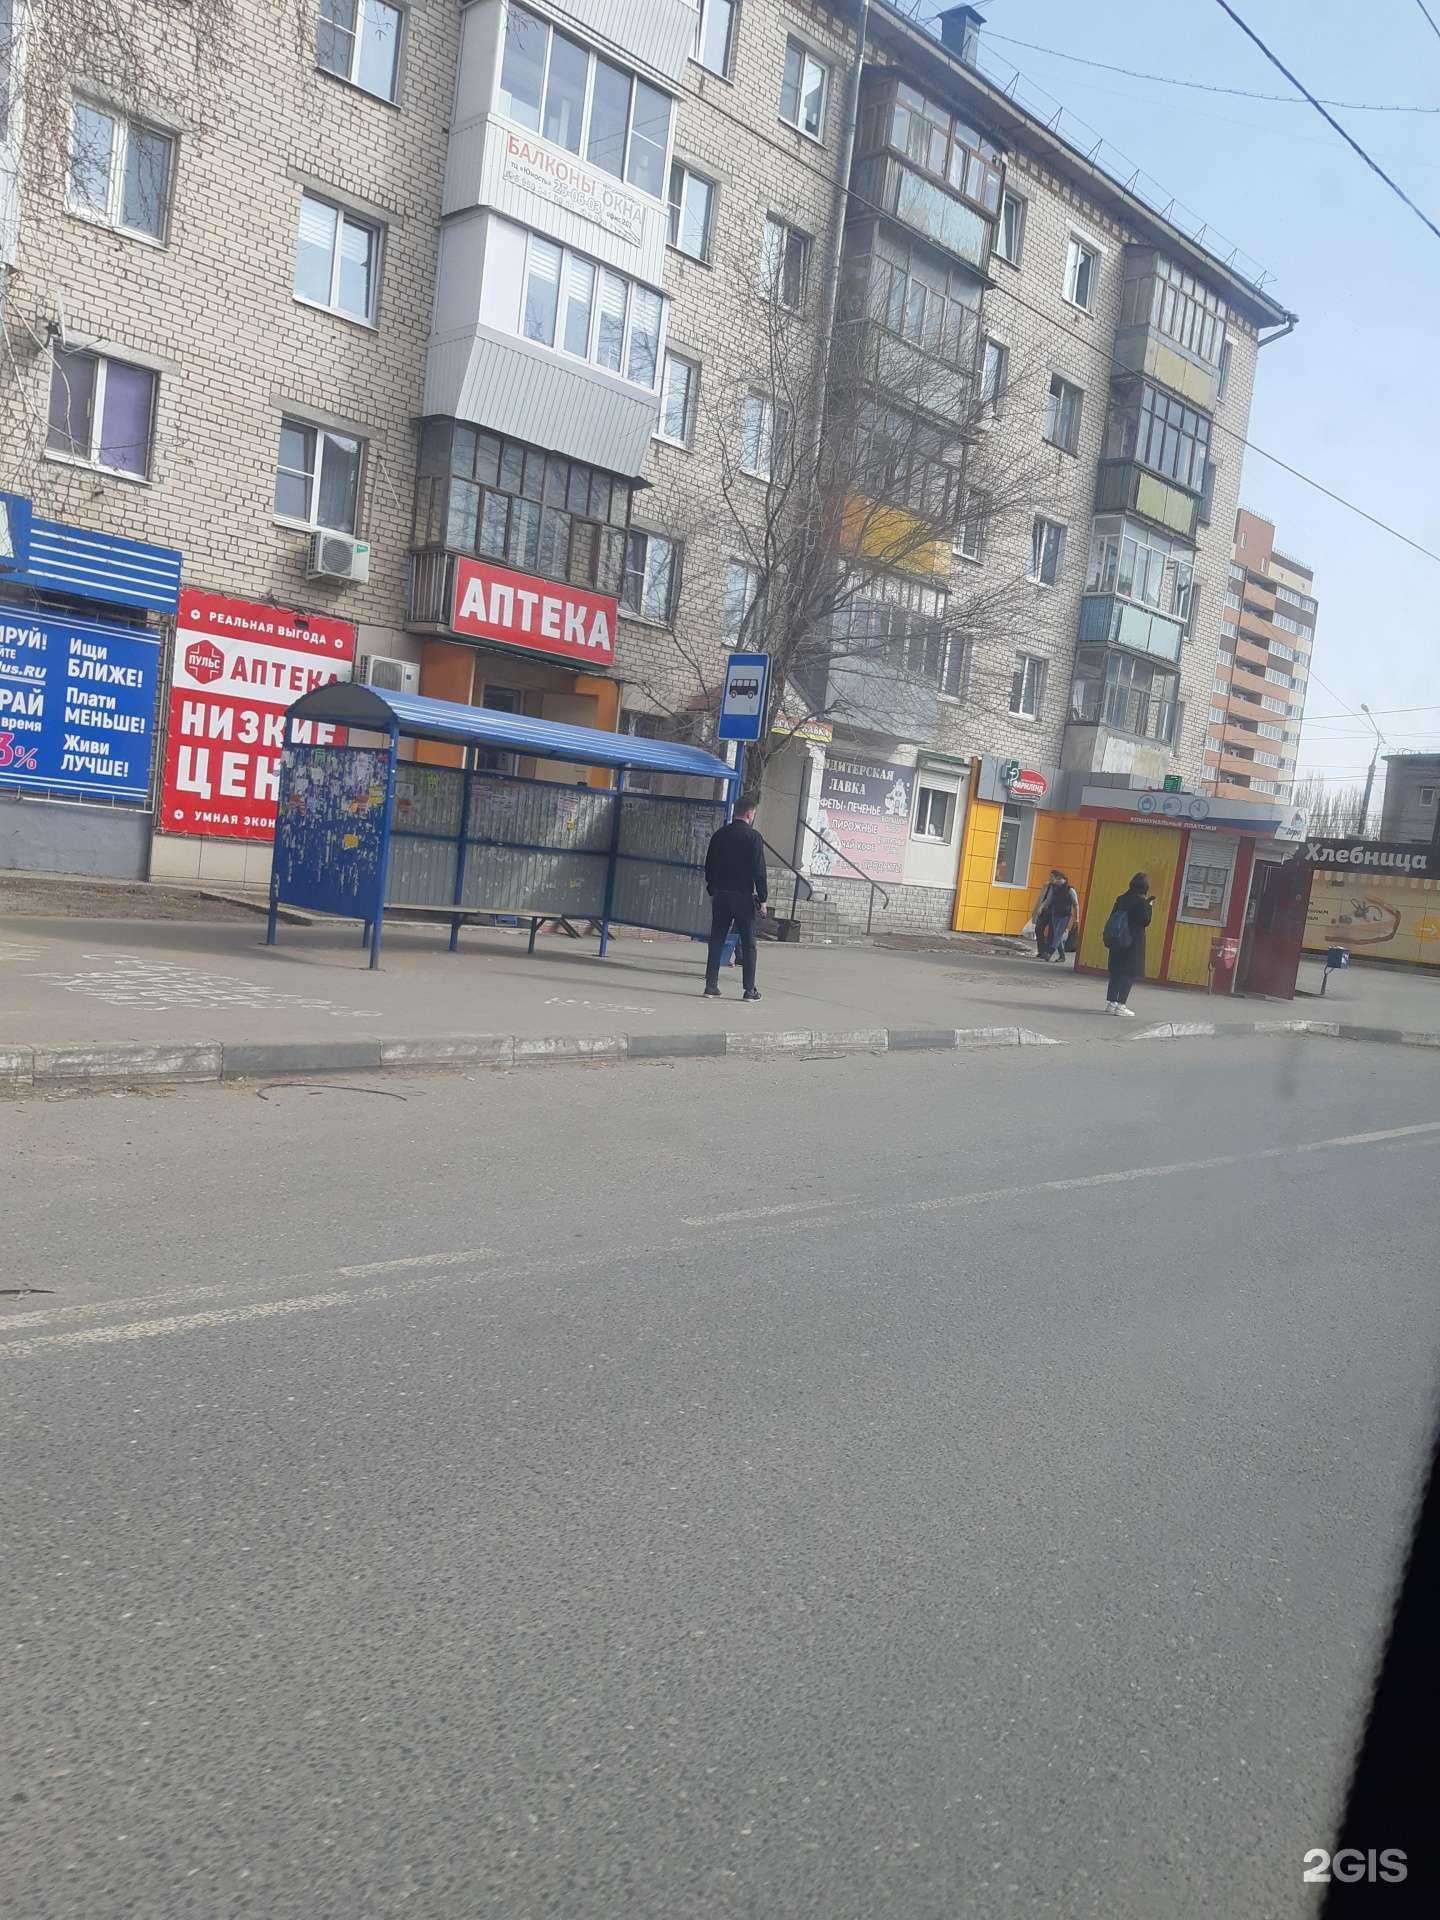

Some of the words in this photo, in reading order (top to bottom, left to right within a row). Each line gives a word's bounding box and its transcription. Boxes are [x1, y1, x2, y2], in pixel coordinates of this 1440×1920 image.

[508, 134, 597, 196] БАЛКОНЫ
[603, 190, 642, 225] ОКНА
[459, 577, 611, 651] АПТЕКА
[209, 612, 273, 634] РЕАЛЬНАЯ
[278, 626, 327, 645] ВЫГОДА
[69, 638, 108, 660] Ищи
[188, 654, 221, 669] ПУЛЬС
[67, 659, 143, 688] БЛИЖЕ!
[66, 687, 116, 709] Плати
[1, 717, 42, 732] время
[65, 707, 146, 735] МЕНЬШЕ!
[181, 700, 336, 748] НИЗКИЕ
[63, 734, 110, 756] Живи
[61, 755, 129, 779] ЛУЧШЕ!
[176, 745, 281, 801] ЦЕН
[829, 779, 866, 795] ЛАВКА
[194, 811, 238, 825] УМНАЯ
[243, 816, 276, 828] ЭКОН
[847, 801, 881, 816] ПЕЧЕНЬЕ
[832, 819, 879, 834] ПИРОЖНЫЕ
[1306, 842, 1428, 873] Хлебница
